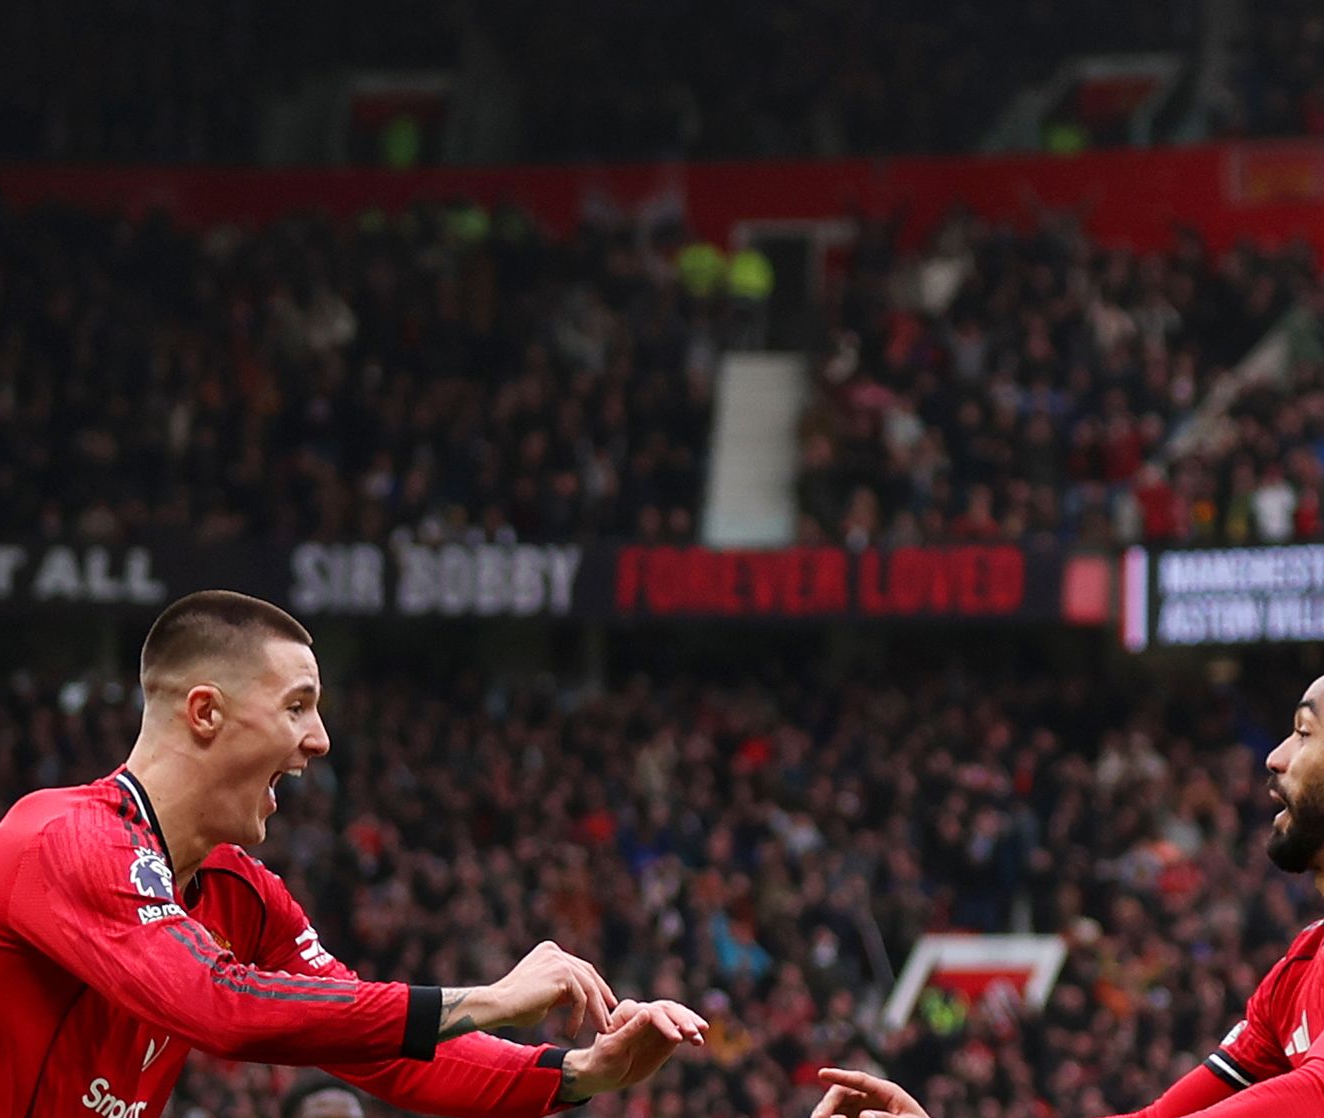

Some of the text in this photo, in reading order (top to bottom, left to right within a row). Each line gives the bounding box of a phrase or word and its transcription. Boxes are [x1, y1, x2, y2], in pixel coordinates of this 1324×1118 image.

[32, 546, 166, 600] ALL
[291, 542, 1025, 615] SIR BOBBY FOREVER LOVED
